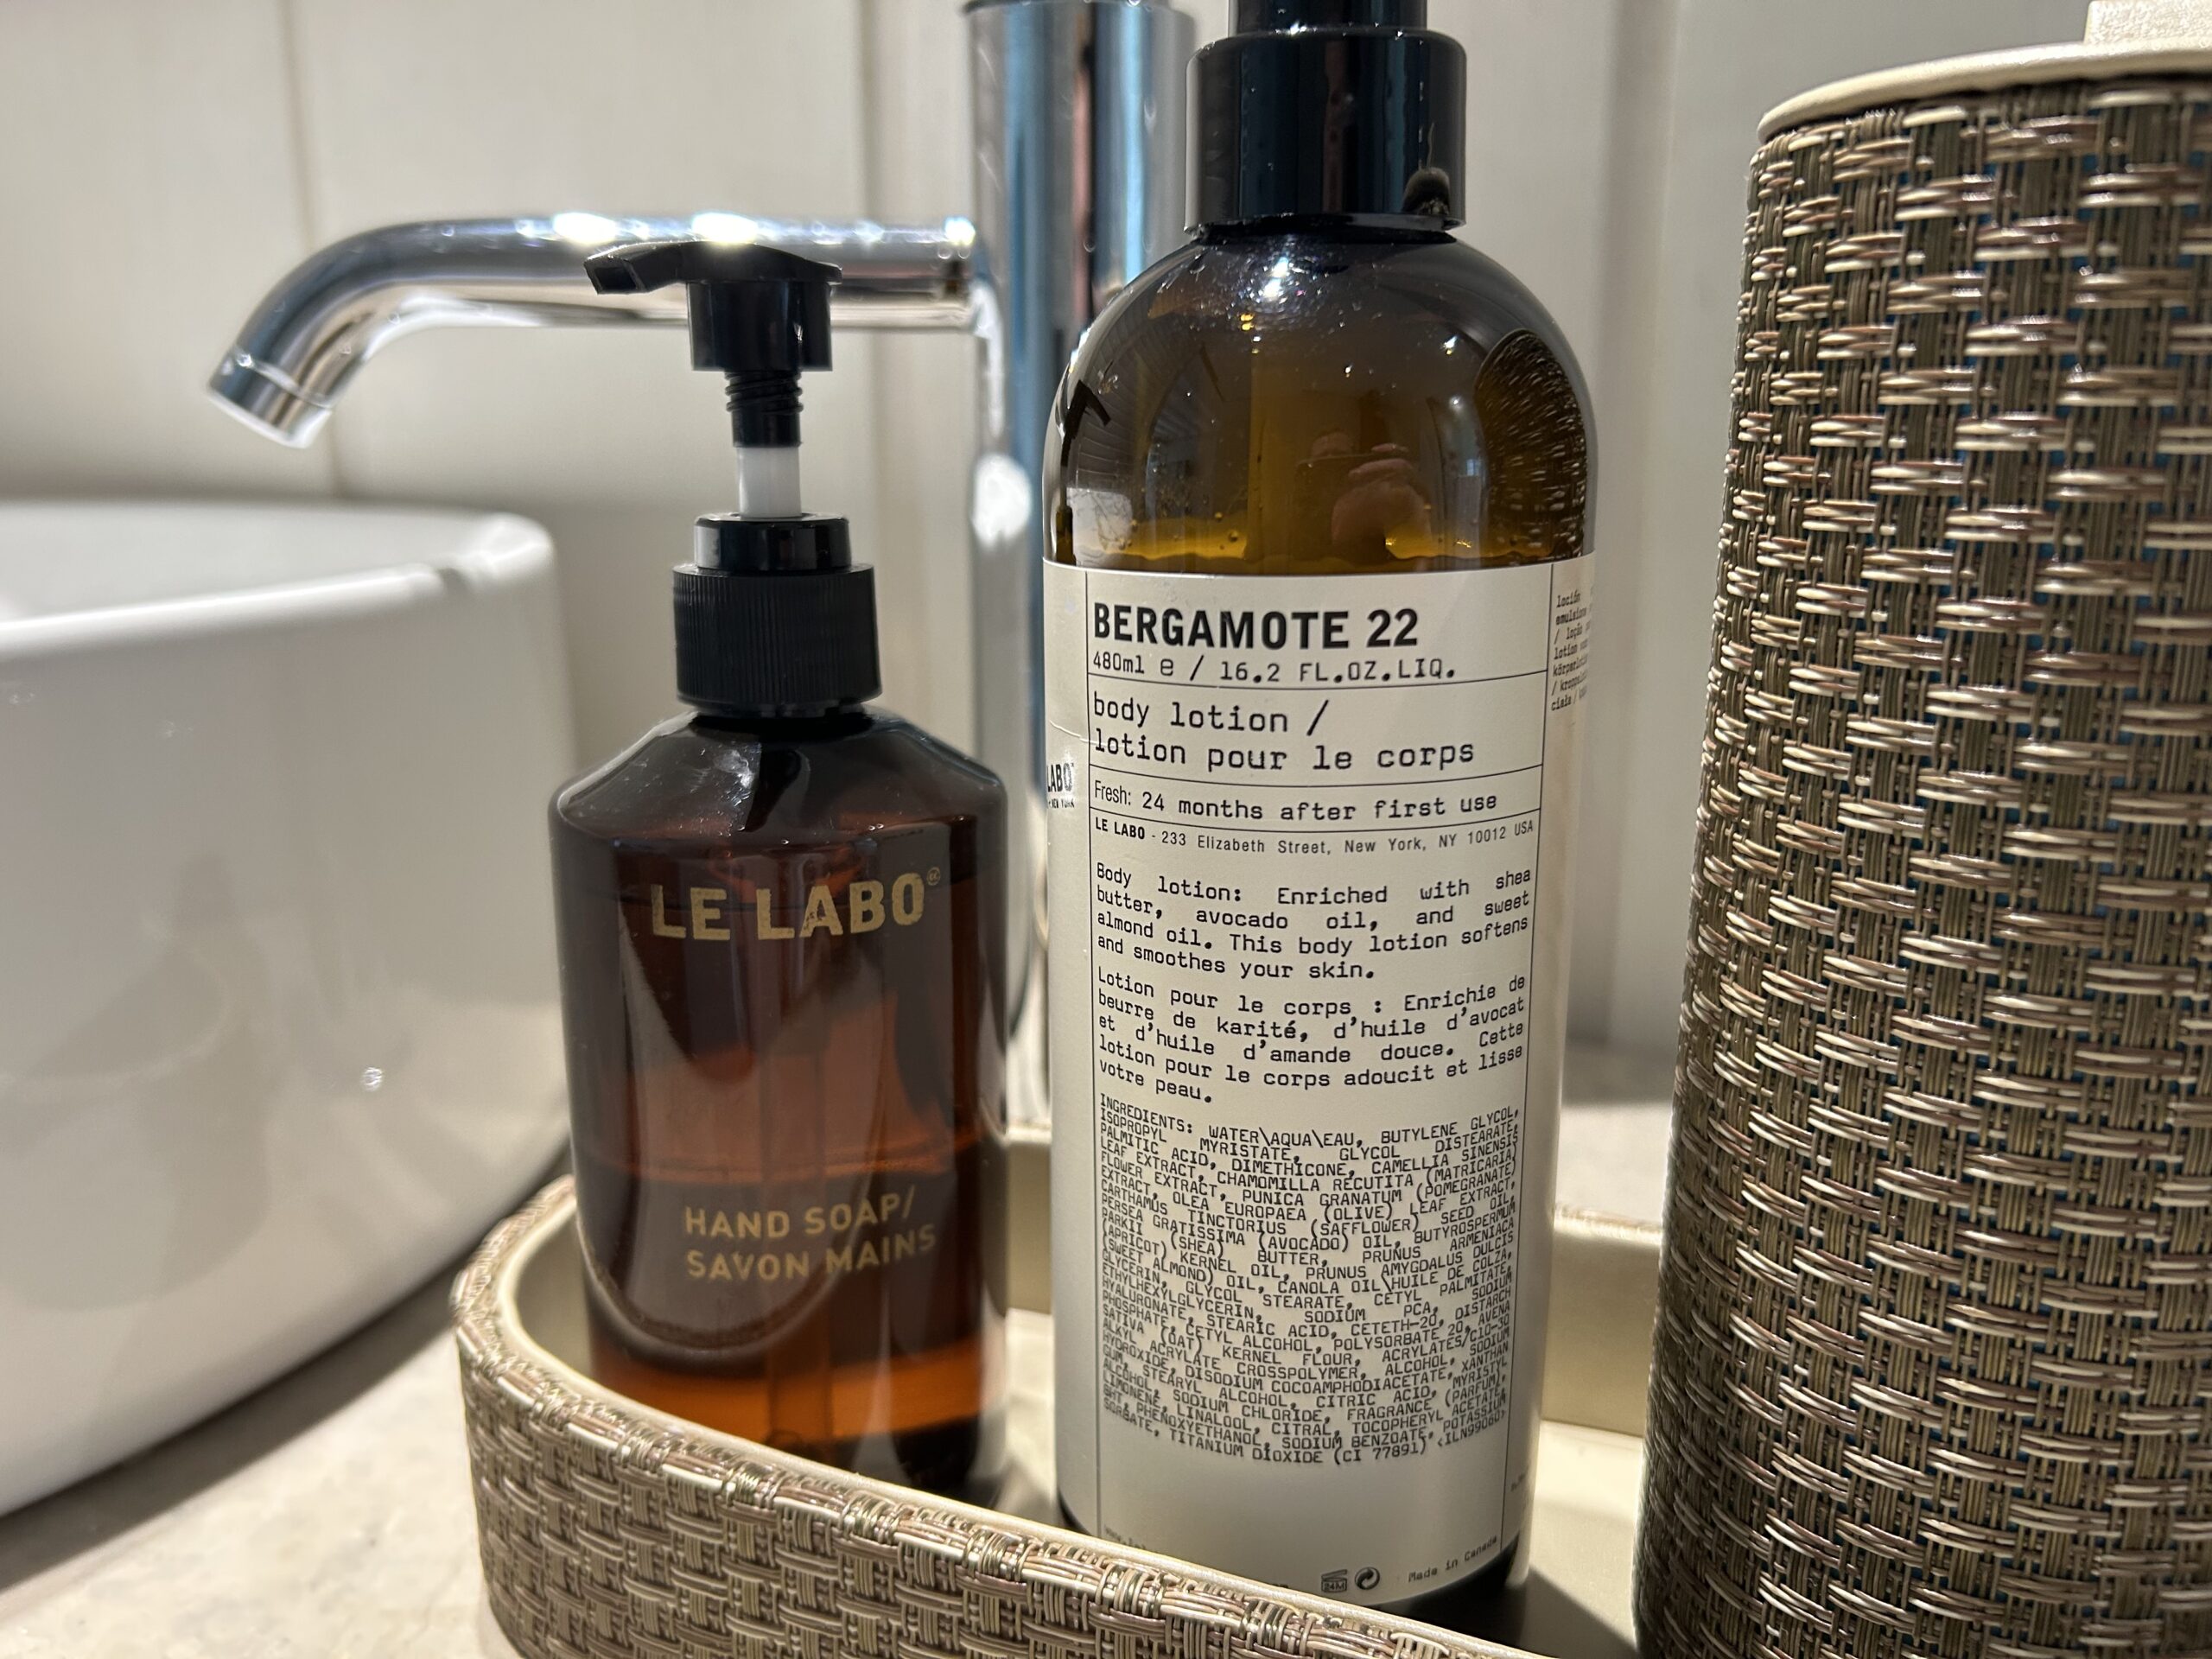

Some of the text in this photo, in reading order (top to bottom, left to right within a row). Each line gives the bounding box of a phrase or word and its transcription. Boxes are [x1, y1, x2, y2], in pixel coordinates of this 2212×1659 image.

[1094, 602, 1418, 650] BERGAMOTE 22
[1092, 651, 1145, 674] 480ml
[1219, 661, 1280, 683] 16.2
[1299, 658, 1455, 683] FL.OZ.LIQ.
[1093, 690, 1149, 728] body
[1169, 702, 1287, 733] lotion
[1094, 728, 1473, 772] lotion pour le corps
[1094, 779, 1131, 806] Fresh:
[1141, 791, 1165, 811] 24
[1178, 799, 1263, 819] months
[1280, 802, 1357, 820] after
[1374, 798, 1446, 818] first
[1459, 796, 1497, 812] use
[1095, 817, 1108, 832] LE
[1114, 822, 1145, 840] LABO
[1161, 830, 1185, 846] 233
[1198, 835, 1264, 852] Elizabeth
[1277, 840, 1331, 855] Street,
[1344, 840, 1376, 853] New
[1388, 837, 1426, 851] York,
[1438, 834, 1457, 848] NY
[1467, 826, 1506, 844] 10012
[1514, 820, 1533, 836] USA
[1096, 862, 1530, 905] Body lotion: Enriched with shea
[651, 884, 730, 940] LE
[1096, 884, 1529, 931] butter, avocado oil, and sweet
[1097, 911, 1528, 957] almond oil. This body lotion softens
[1097, 936, 1374, 979] and smoothes your skin.
[1098, 966, 1154, 998] Lotion
[1170, 989, 1218, 1008] pour
[1237, 995, 1263, 1013] le
[1283, 1002, 1351, 1020] corps
[1403, 984, 1496, 1011] Enrichie
[1509, 975, 1525, 992] de
[1098, 988, 1154, 1020] beurre
[1173, 1010, 1196, 1028] de
[1217, 1016, 1308, 1042] karité,
[1098, 1015, 1116, 1032] et
[1380, 1044, 1453, 1060] douce.
[1478, 1023, 1523, 1047] Cette
[1099, 1033, 1522, 1090] lotion pour le corps adoucit et lisse
[1099, 1059, 1211, 1103] votre peau.
[1100, 1093, 1192, 1134] INGREDIENTS:
[1380, 1122, 1457, 1144] BUTYLENE
[1135, 1151, 1414, 1191] EXTRACT, CHAMOMILLA RECUTITA
[1171, 1147, 1449, 1178] ACID, DIMETHICONE, CAMELLIA
[1199, 1139, 1401, 1163] MYRISTATE, GLYCOL
[1154, 1172, 1402, 1206] EXTRACT, PUNICA GRANATUM
[1172, 1192, 1444, 1223] OLEA EUROPAEA (OLIVE) LEAF
[685, 1185, 915, 1239] HAND SOAP/
[1190, 1211, 1419, 1238] TINCTORIUS (SAFFLOWER)
[687, 1224, 937, 1281] SAVON MAINS
[1257, 1249, 1327, 1267] BUTTER,
[1362, 1246, 1421, 1263] PRUNUS
[1258, 1233, 1349, 1253] (AVOCADO)
[1362, 1236, 1401, 1249] OIL,
[1250, 1264, 1289, 1281] OIL,
[1306, 1267, 1366, 1280] PRUNUS
[1277, 1281, 1339, 1294] CANOLA
[1262, 1294, 1352, 1311] STEARATE,
[1287, 1325, 1337, 1339] ACID,
[1408, 1535, 1497, 1583] Made in Canada
